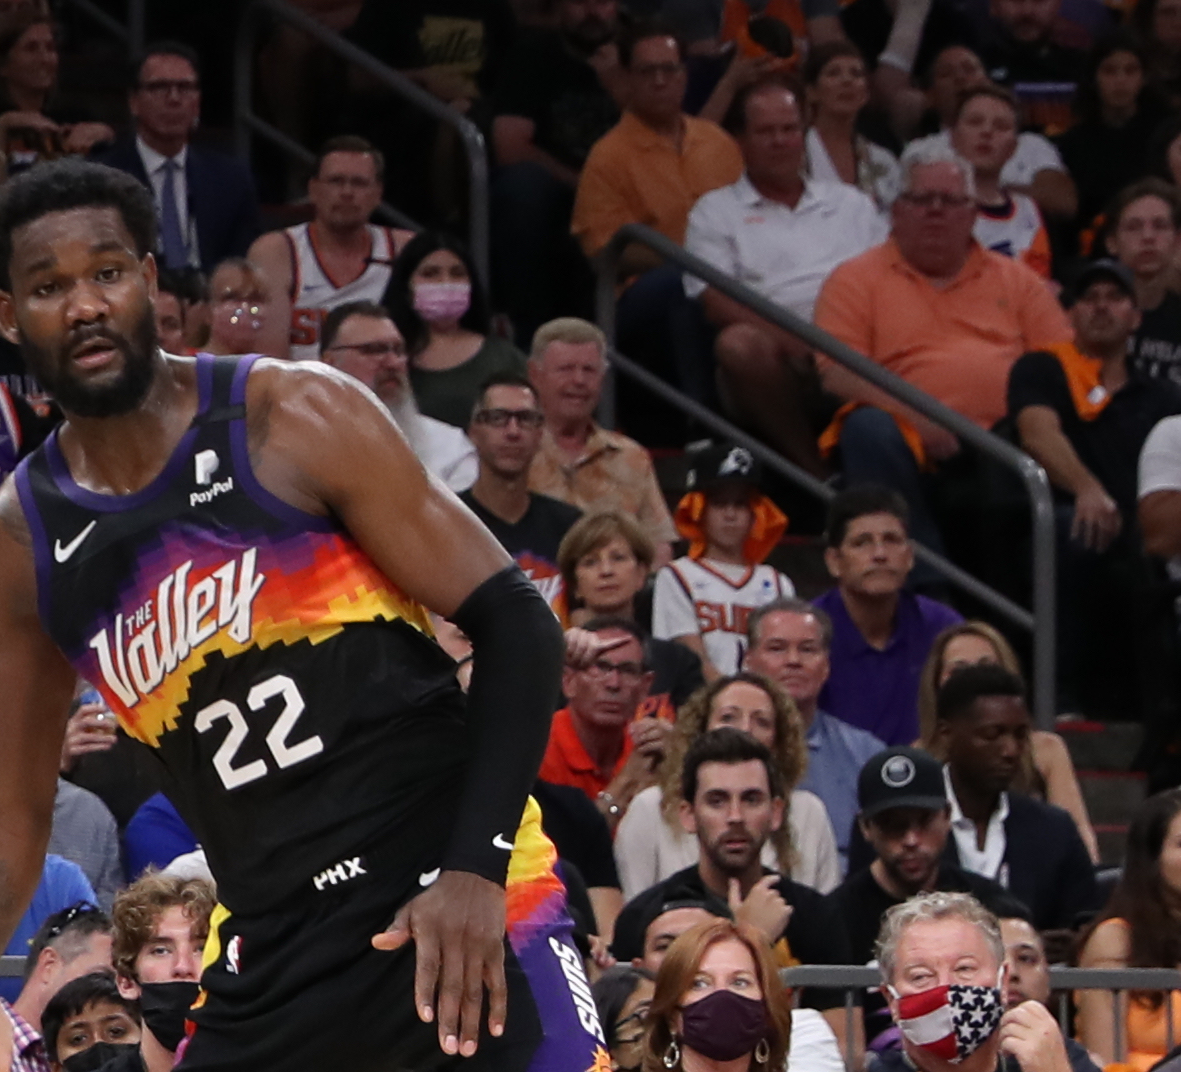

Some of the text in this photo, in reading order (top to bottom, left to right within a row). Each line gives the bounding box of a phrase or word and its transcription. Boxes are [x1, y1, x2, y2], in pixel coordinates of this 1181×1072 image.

[190, 477, 233, 506] PayPal
[89, 547, 266, 708] Valley
[126, 600, 152, 636] THE
[194, 675, 323, 790] 22
[548, 937, 606, 1045] SUNS
